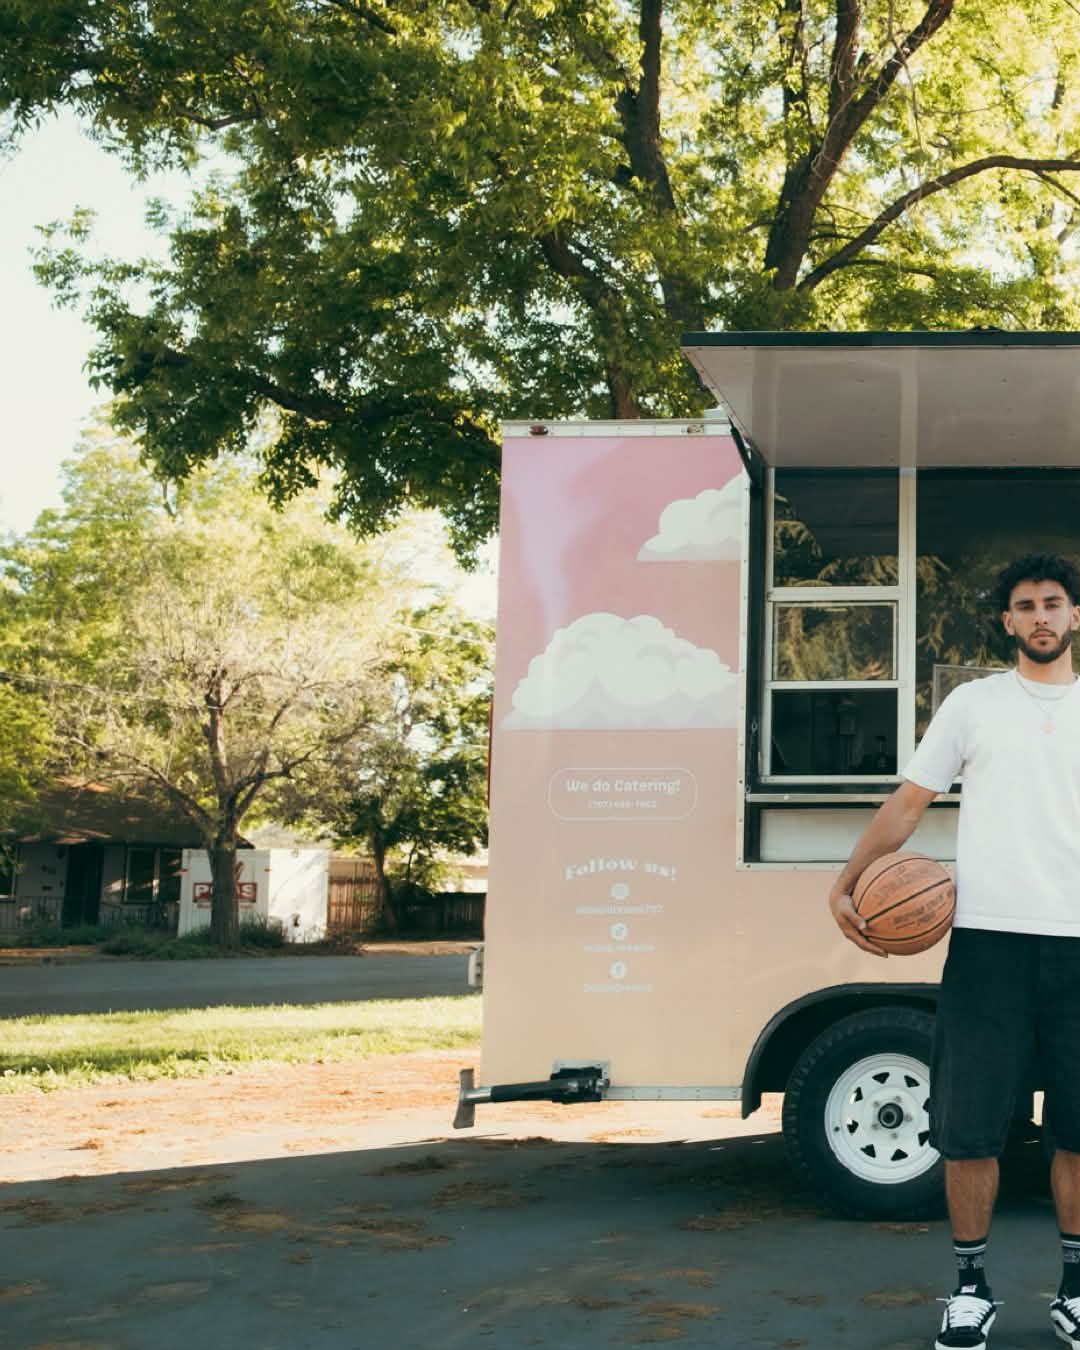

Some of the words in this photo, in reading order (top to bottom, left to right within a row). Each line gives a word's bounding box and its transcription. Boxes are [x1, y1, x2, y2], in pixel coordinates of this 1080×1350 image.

[566, 779, 588, 793] We
[592, 779, 609, 793] do
[614, 779, 681, 795] Catering!
[566, 857, 636, 880] Follow
[195, 884, 254, 897] PS
